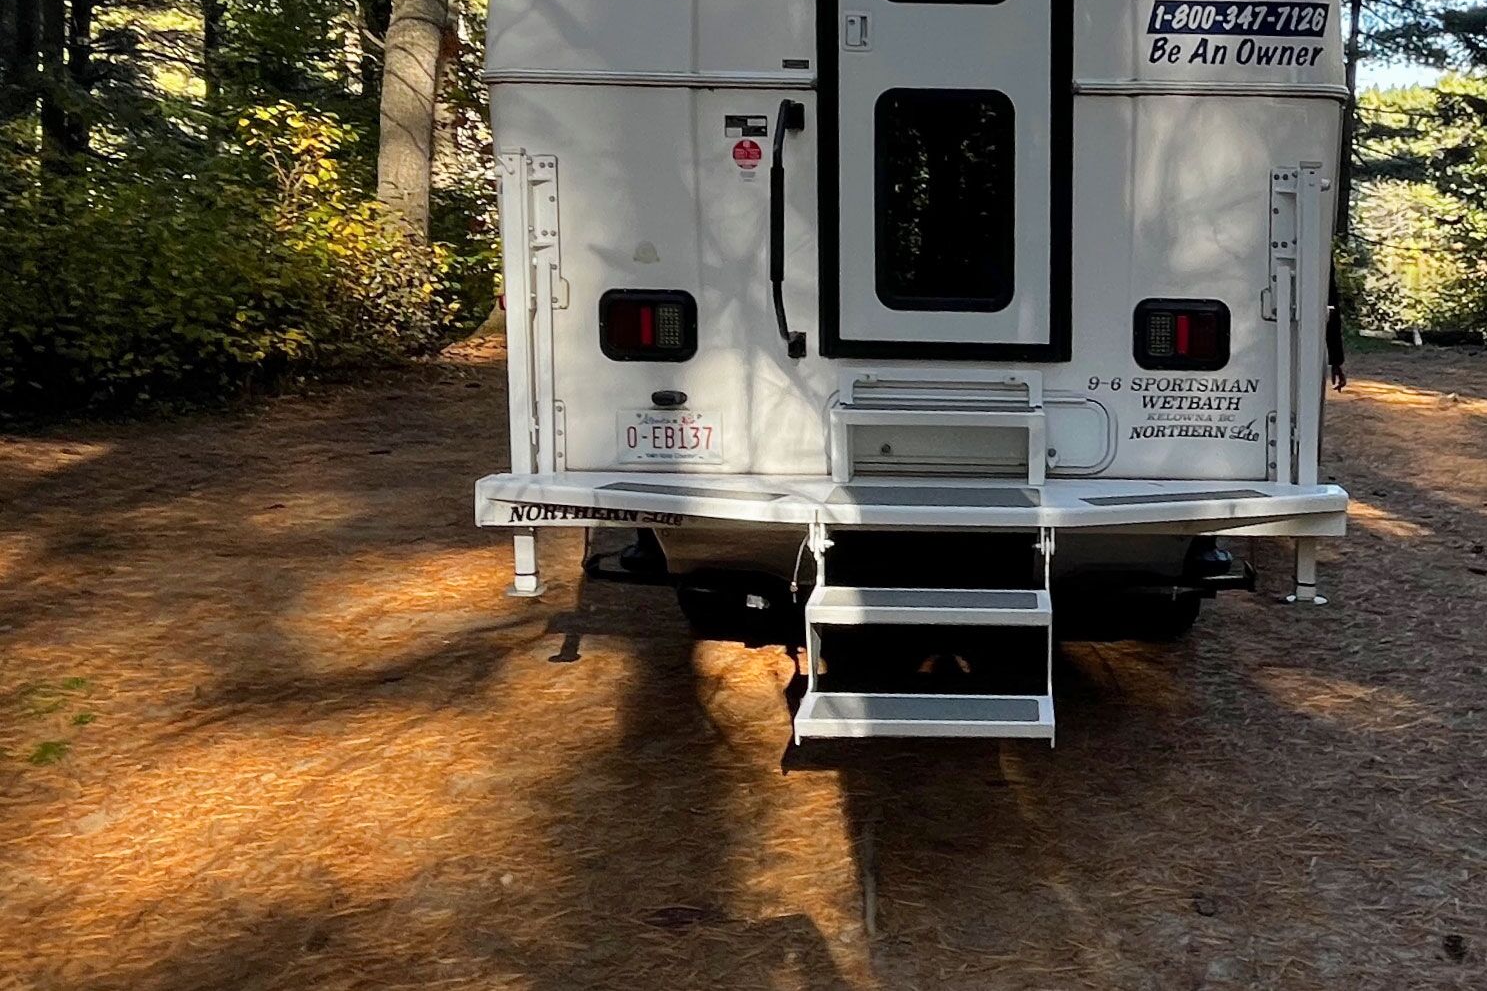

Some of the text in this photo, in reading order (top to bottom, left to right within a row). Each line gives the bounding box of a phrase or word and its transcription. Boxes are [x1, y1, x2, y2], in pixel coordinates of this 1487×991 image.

[1154, 3, 1326, 31] 1-800-347-7126
[1149, 36, 1324, 66] Be An Owner
[1087, 375, 1260, 393] 9-6 SPORTSMAN
[1141, 395, 1243, 411] WETBATH
[1146, 412, 1236, 423] KELOWNA BC
[1129, 419, 1260, 442] NORTHERN Lite
[508, 504, 639, 524] NORTHERN
